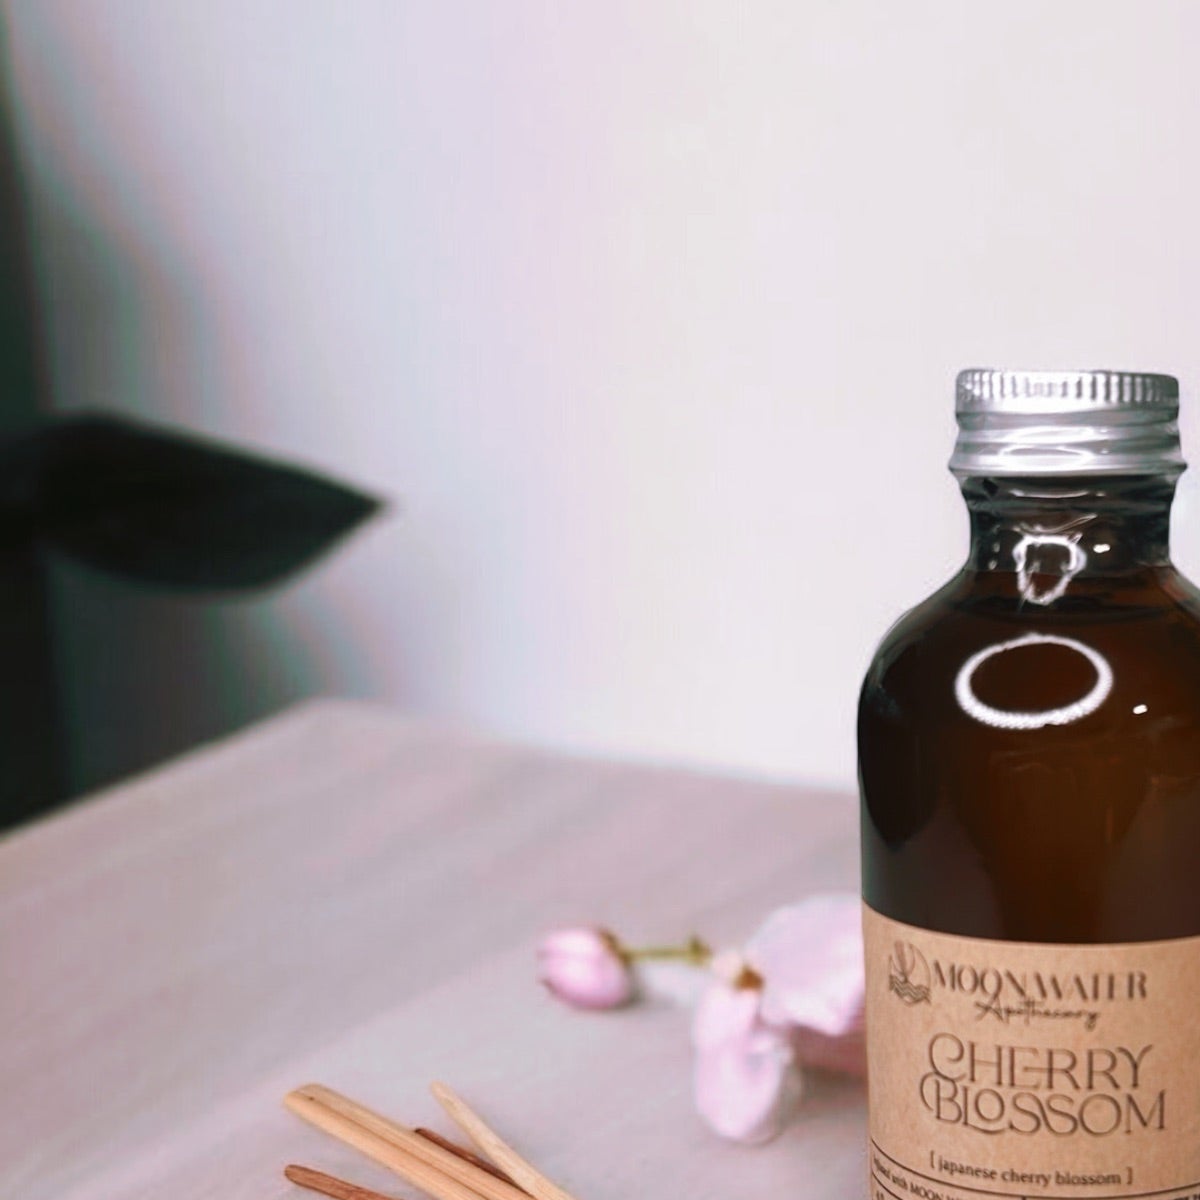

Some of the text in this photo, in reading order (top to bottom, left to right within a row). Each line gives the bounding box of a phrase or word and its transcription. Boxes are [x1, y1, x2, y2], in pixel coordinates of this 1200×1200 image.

[974, 996, 1100, 1033] Apothecary
[927, 1031, 1154, 1091] CHERRY
[918, 1071, 1167, 1138] BLOSSOM
[938, 1156, 997, 1179] japanese
[1001, 1169, 1051, 1187] cherry
[1054, 1170, 1122, 1187] blossom
